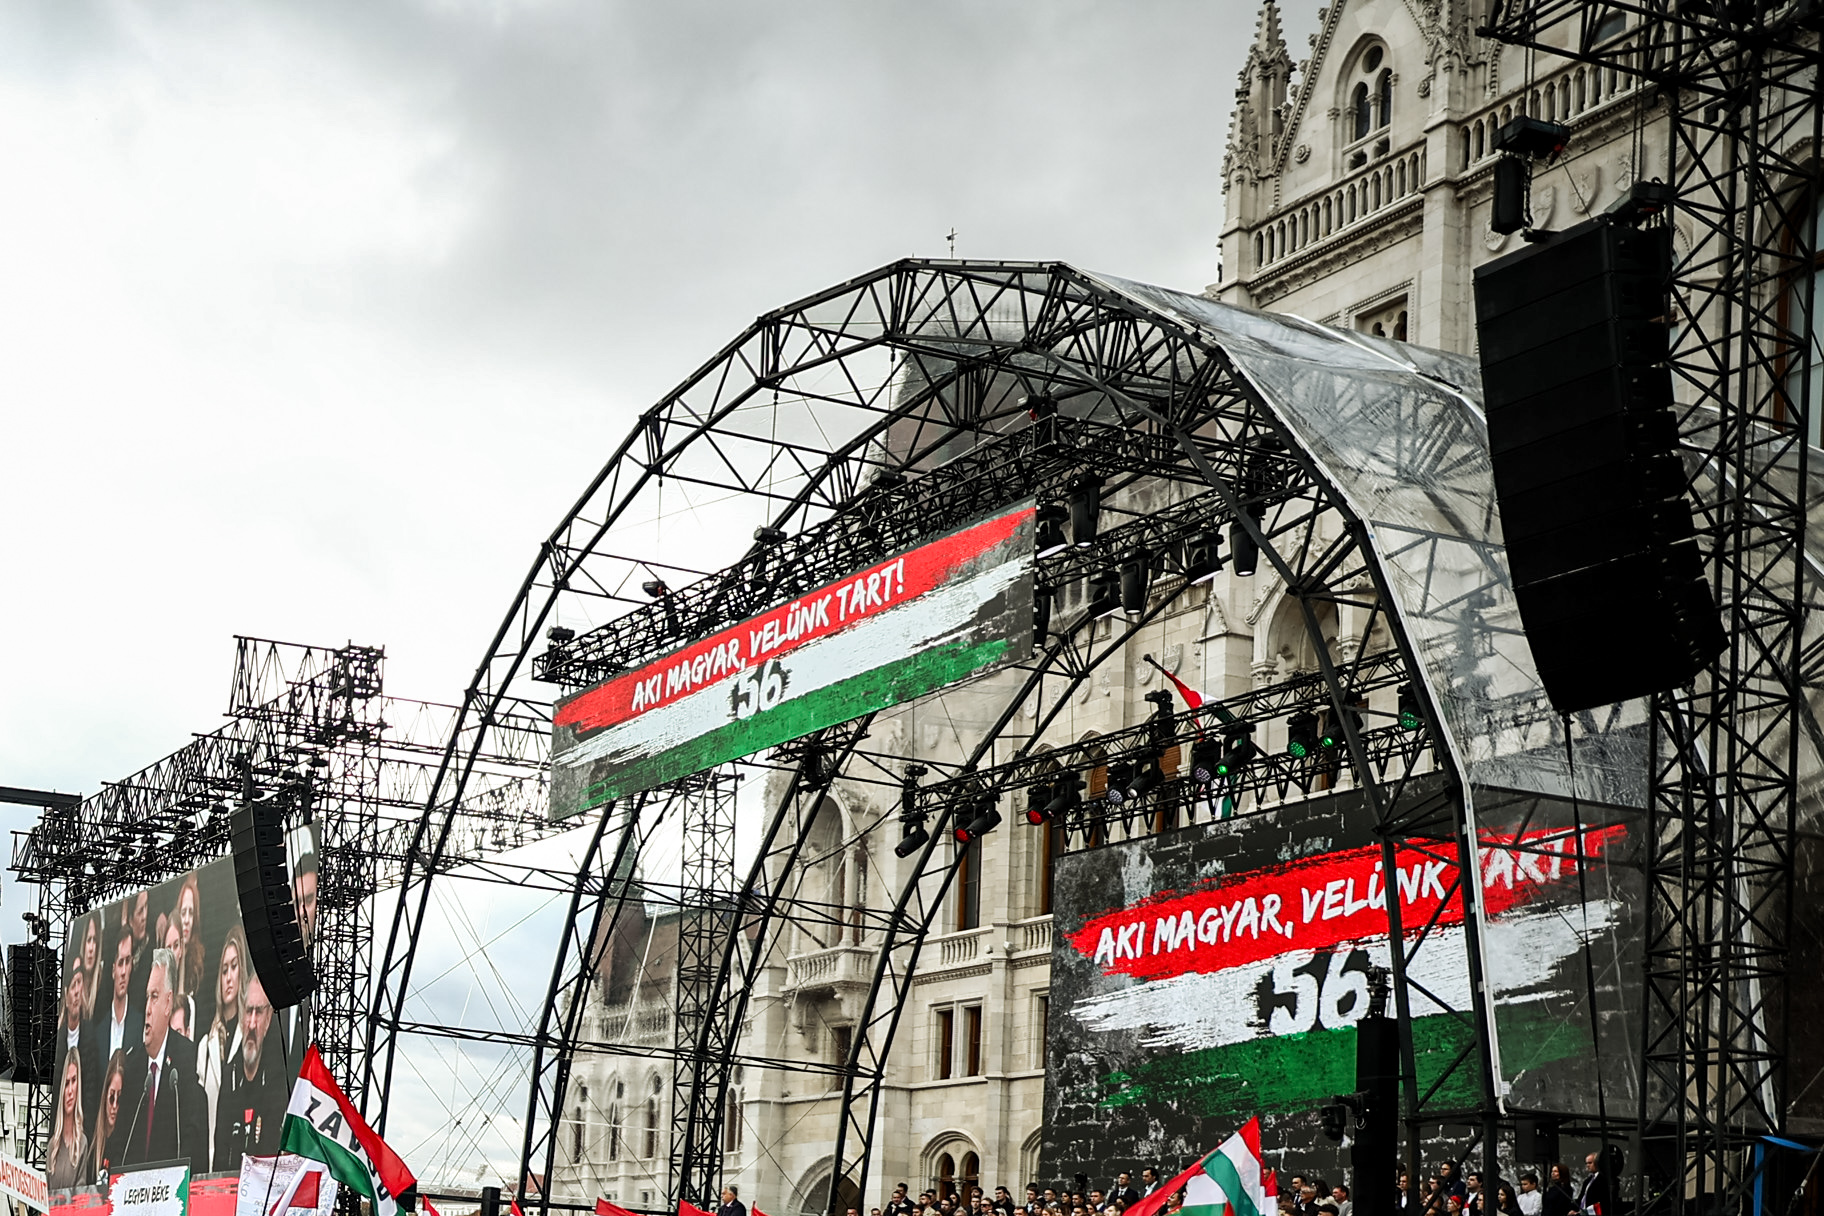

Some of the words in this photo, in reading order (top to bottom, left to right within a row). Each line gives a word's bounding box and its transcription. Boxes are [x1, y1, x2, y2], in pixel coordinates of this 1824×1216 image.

[632, 673, 662, 712] AKI
[666, 638, 746, 698] MAGYAR,
[750, 595, 831, 658] VELÜNK
[836, 558, 905, 621] TART!
[737, 661, 782, 720] 56
[1094, 921, 1145, 967] AKI
[1153, 893, 1294, 955] MAGYAR,
[1478, 824, 1587, 890] ART!
[1270, 945, 1370, 1035] 56
[124, 1185, 150, 1206] LEGYEN
[151, 1180, 170, 1203] BÉKE
